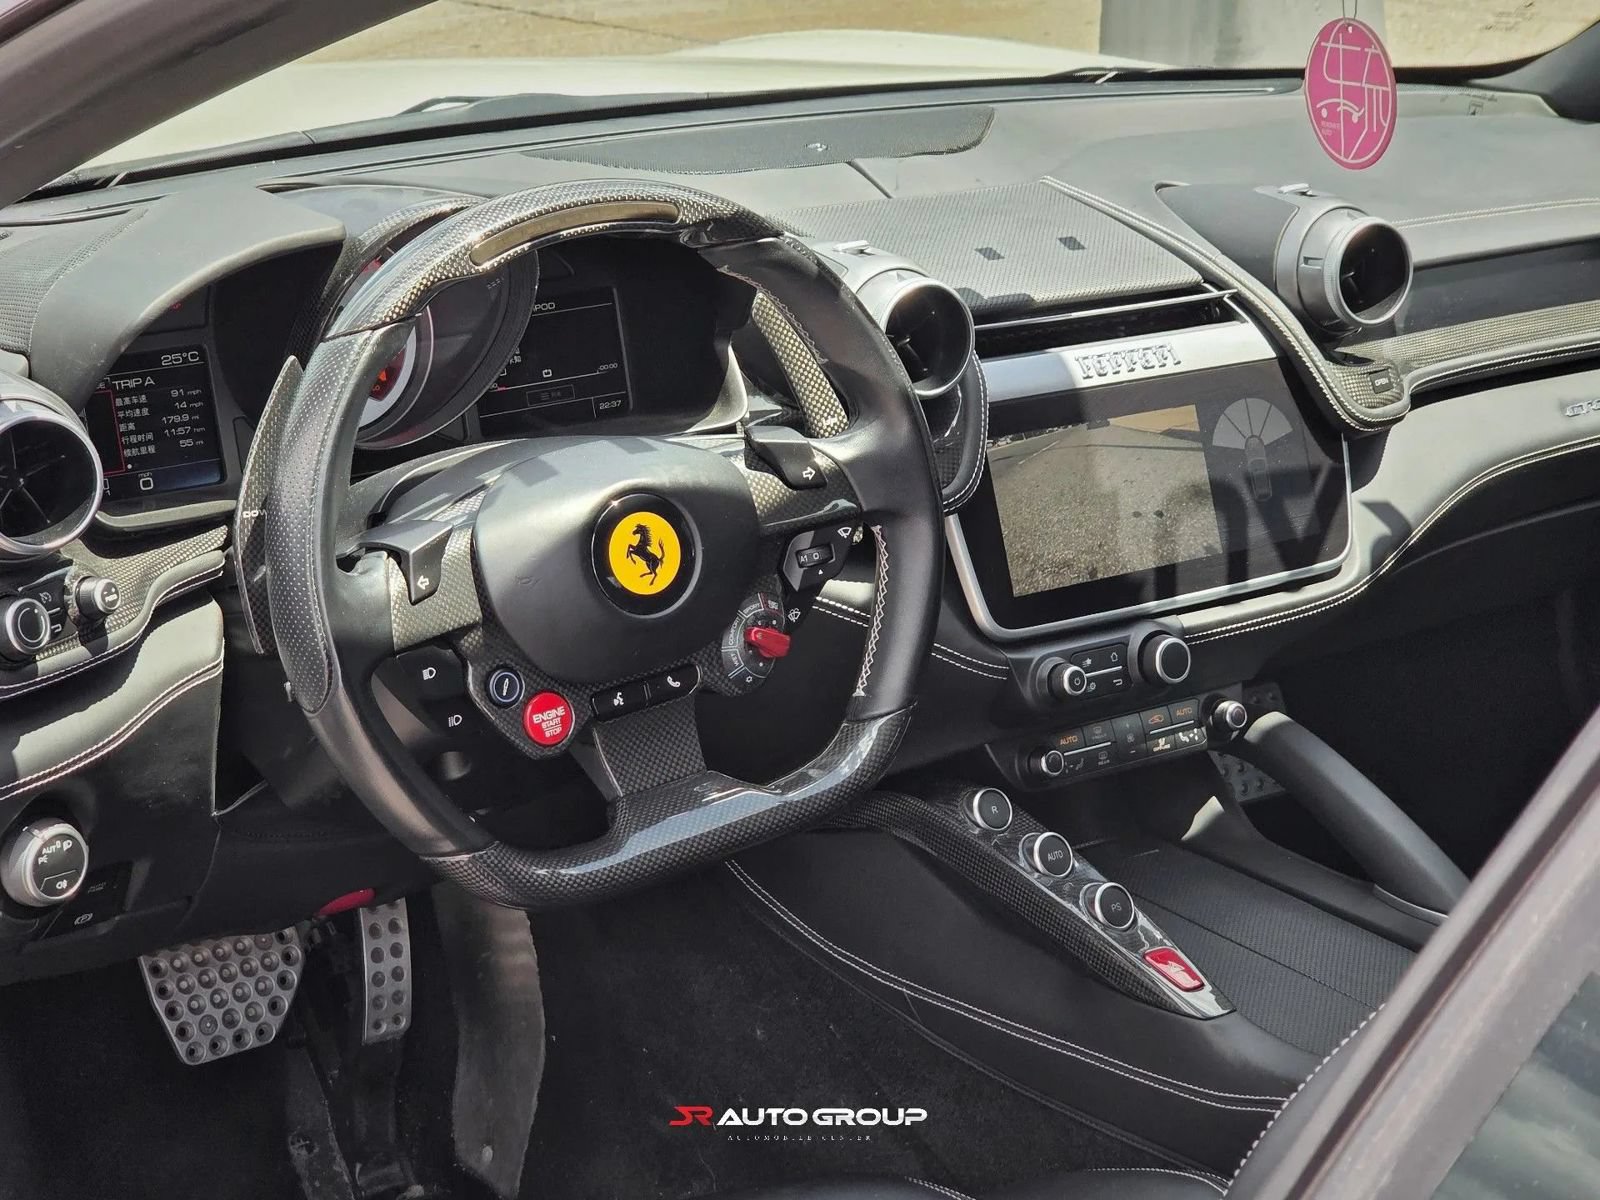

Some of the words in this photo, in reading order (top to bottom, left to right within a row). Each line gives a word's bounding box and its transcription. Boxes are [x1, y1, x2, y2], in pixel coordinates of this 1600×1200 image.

[160, 351, 200, 366] 25°C
[112, 378, 142, 390] TRIP
[144, 376, 156, 387] A
[170, 389, 185, 398] 91
[174, 401, 187, 410] 14
[600, 400, 622, 410] 22:37
[179, 439, 194, 448] 55
[743, 603, 761, 614] SPORT
[729, 616, 741, 645] COMFORT
[532, 706, 566, 724] ENGINE
[1175, 706, 1193, 717] AUTO
[541, 717, 561, 729] START
[544, 726, 562, 738] STOP
[1059, 735, 1078, 746] AUTO
[991, 805, 999, 815] R
[42, 840, 61, 854] AUTO
[1047, 849, 1064, 861] AUTO
[1111, 902, 1122, 912] PS
